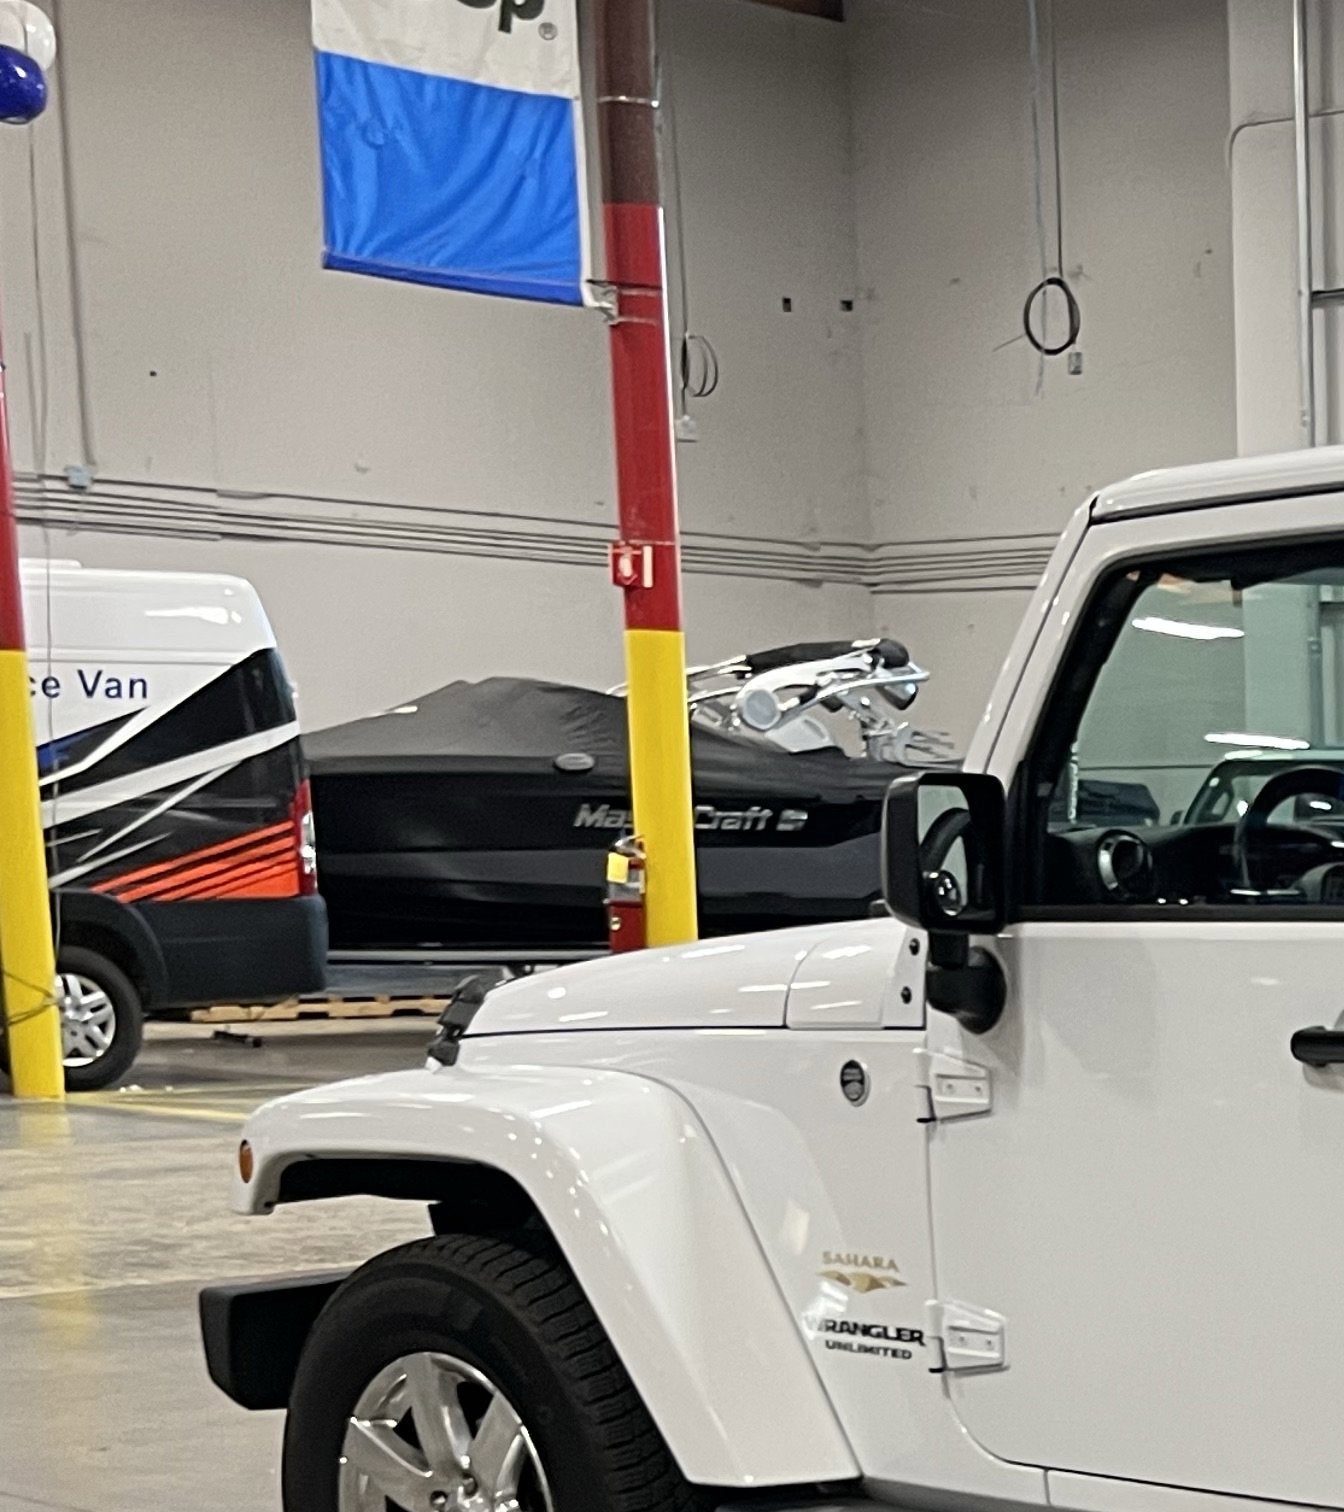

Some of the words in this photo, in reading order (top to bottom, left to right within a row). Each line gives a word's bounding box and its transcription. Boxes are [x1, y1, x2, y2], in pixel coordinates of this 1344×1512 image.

[77, 669, 147, 699] Van
[822, 1251, 900, 1273] SAHARA
[825, 1340, 913, 1360] UNLIMITED
